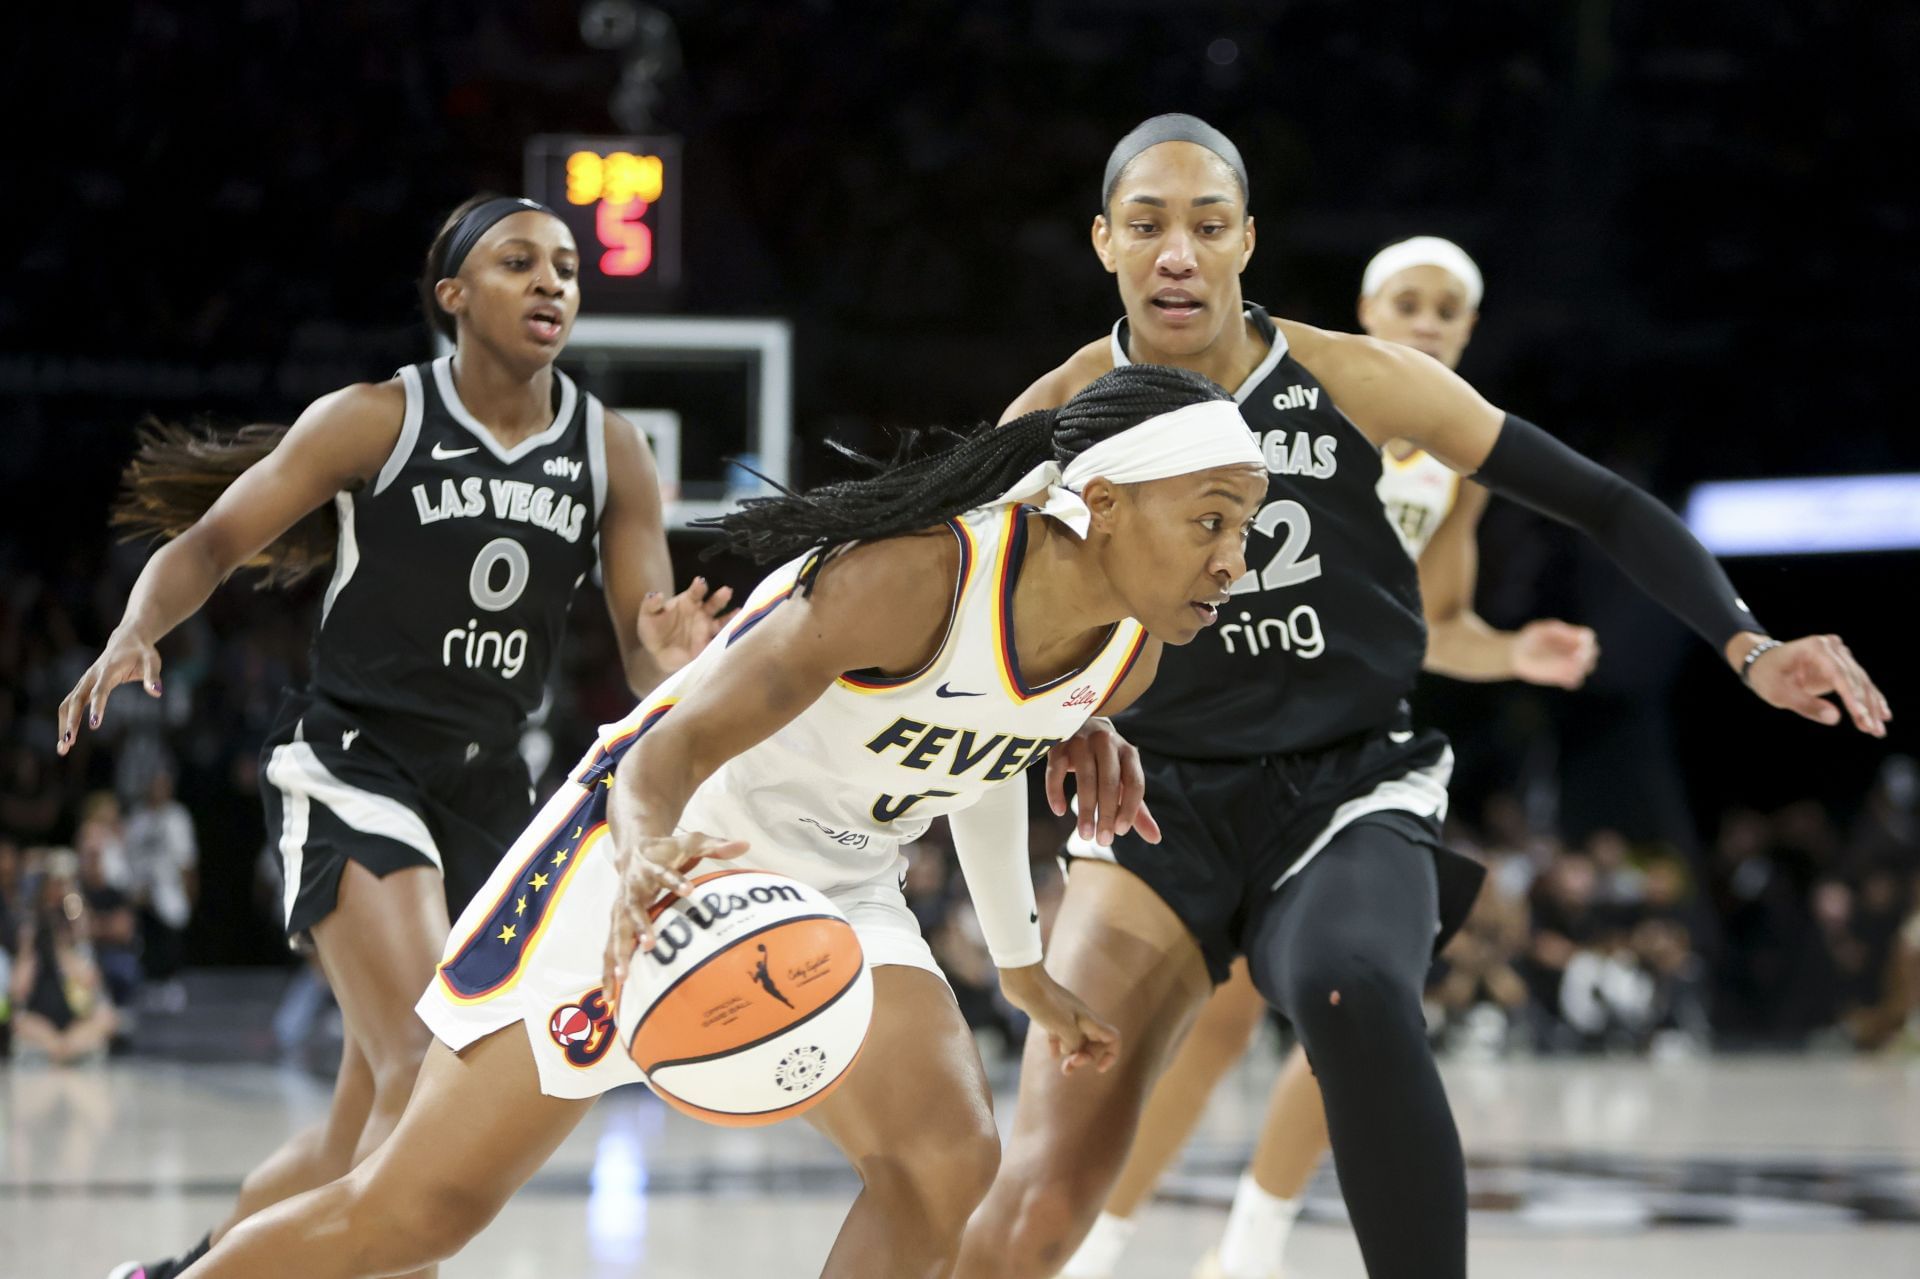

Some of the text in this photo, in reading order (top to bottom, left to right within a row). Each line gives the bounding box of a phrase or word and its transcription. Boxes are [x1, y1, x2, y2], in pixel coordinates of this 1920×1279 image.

[596, 197, 652, 276] 5
[1273, 385, 1319, 410] ally
[543, 456, 583, 482] ally
[1257, 429, 1338, 480] GAS
[411, 477, 587, 543] LAS VEGAS
[469, 537, 530, 612] 0
[1229, 500, 1322, 596] 2
[443, 618, 528, 679] ring
[1219, 605, 1325, 659] ring
[1062, 684, 1098, 710] Lilly
